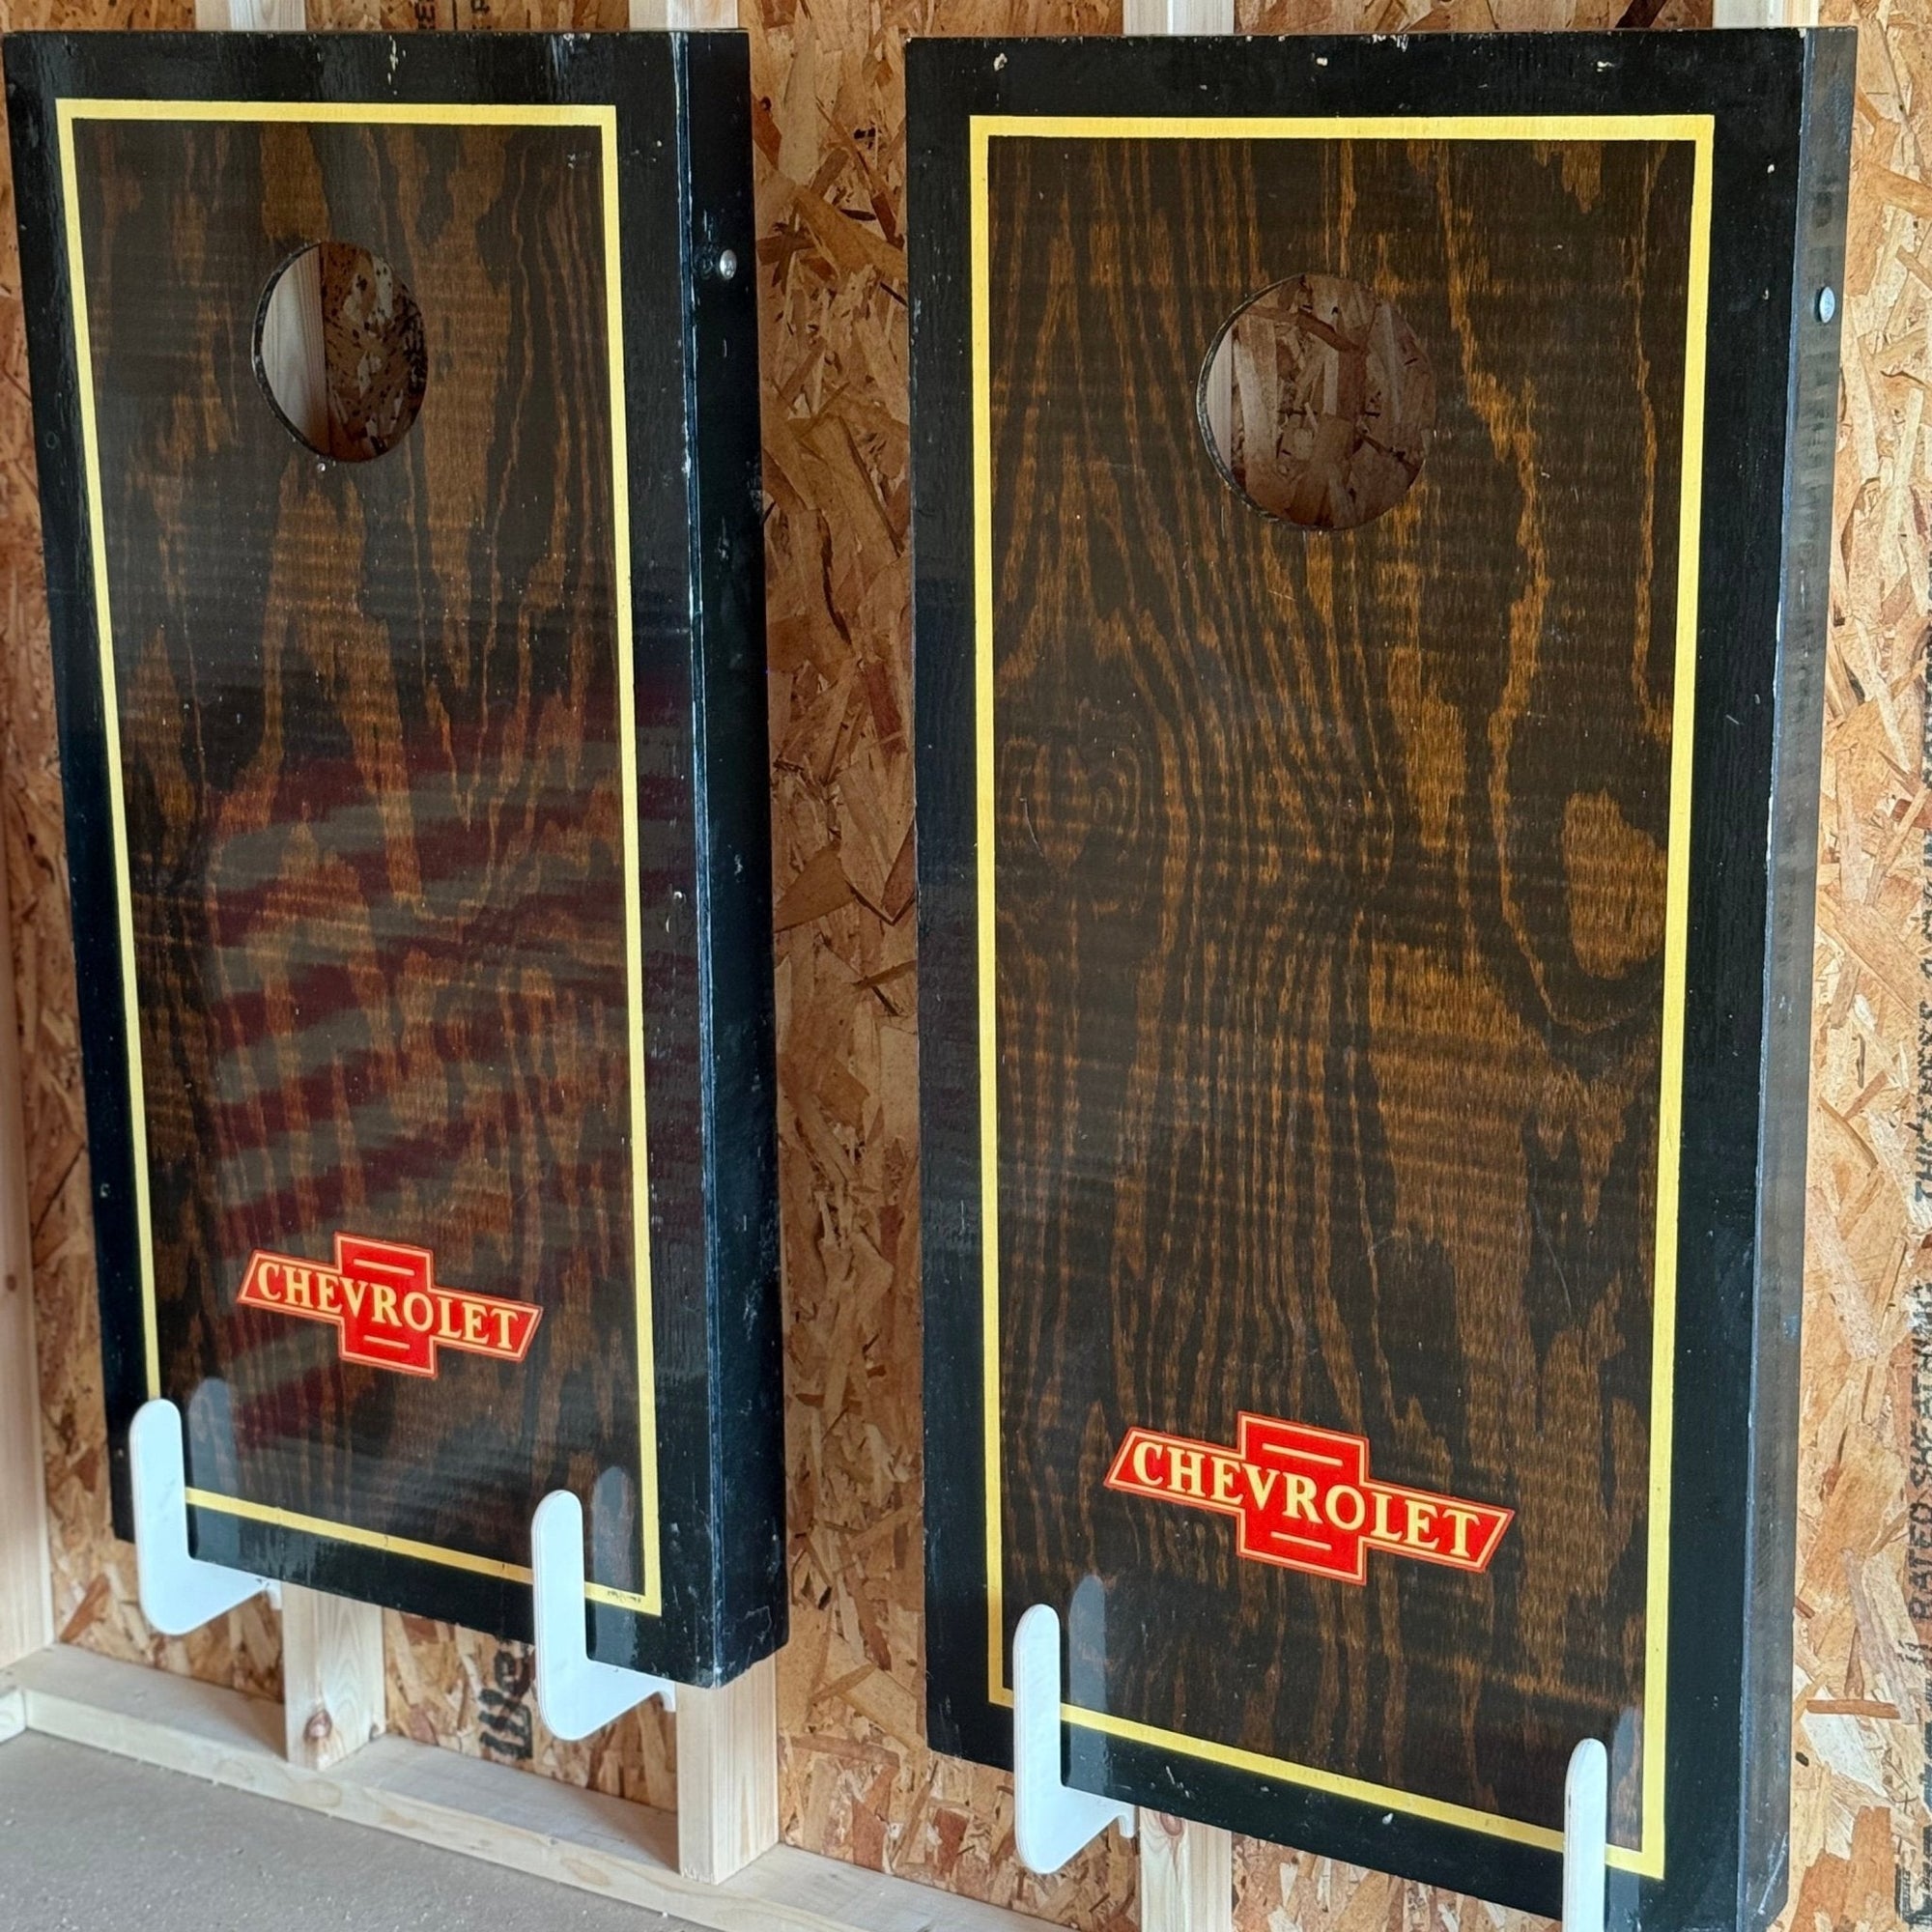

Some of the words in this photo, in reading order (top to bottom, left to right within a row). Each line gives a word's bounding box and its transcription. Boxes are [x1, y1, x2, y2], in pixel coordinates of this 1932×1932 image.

[257, 1262, 520, 1350] CHEVROLET
[1133, 1441, 1481, 1557] CHEVROLET
[1908, 1502, 1932, 1619] RATED
